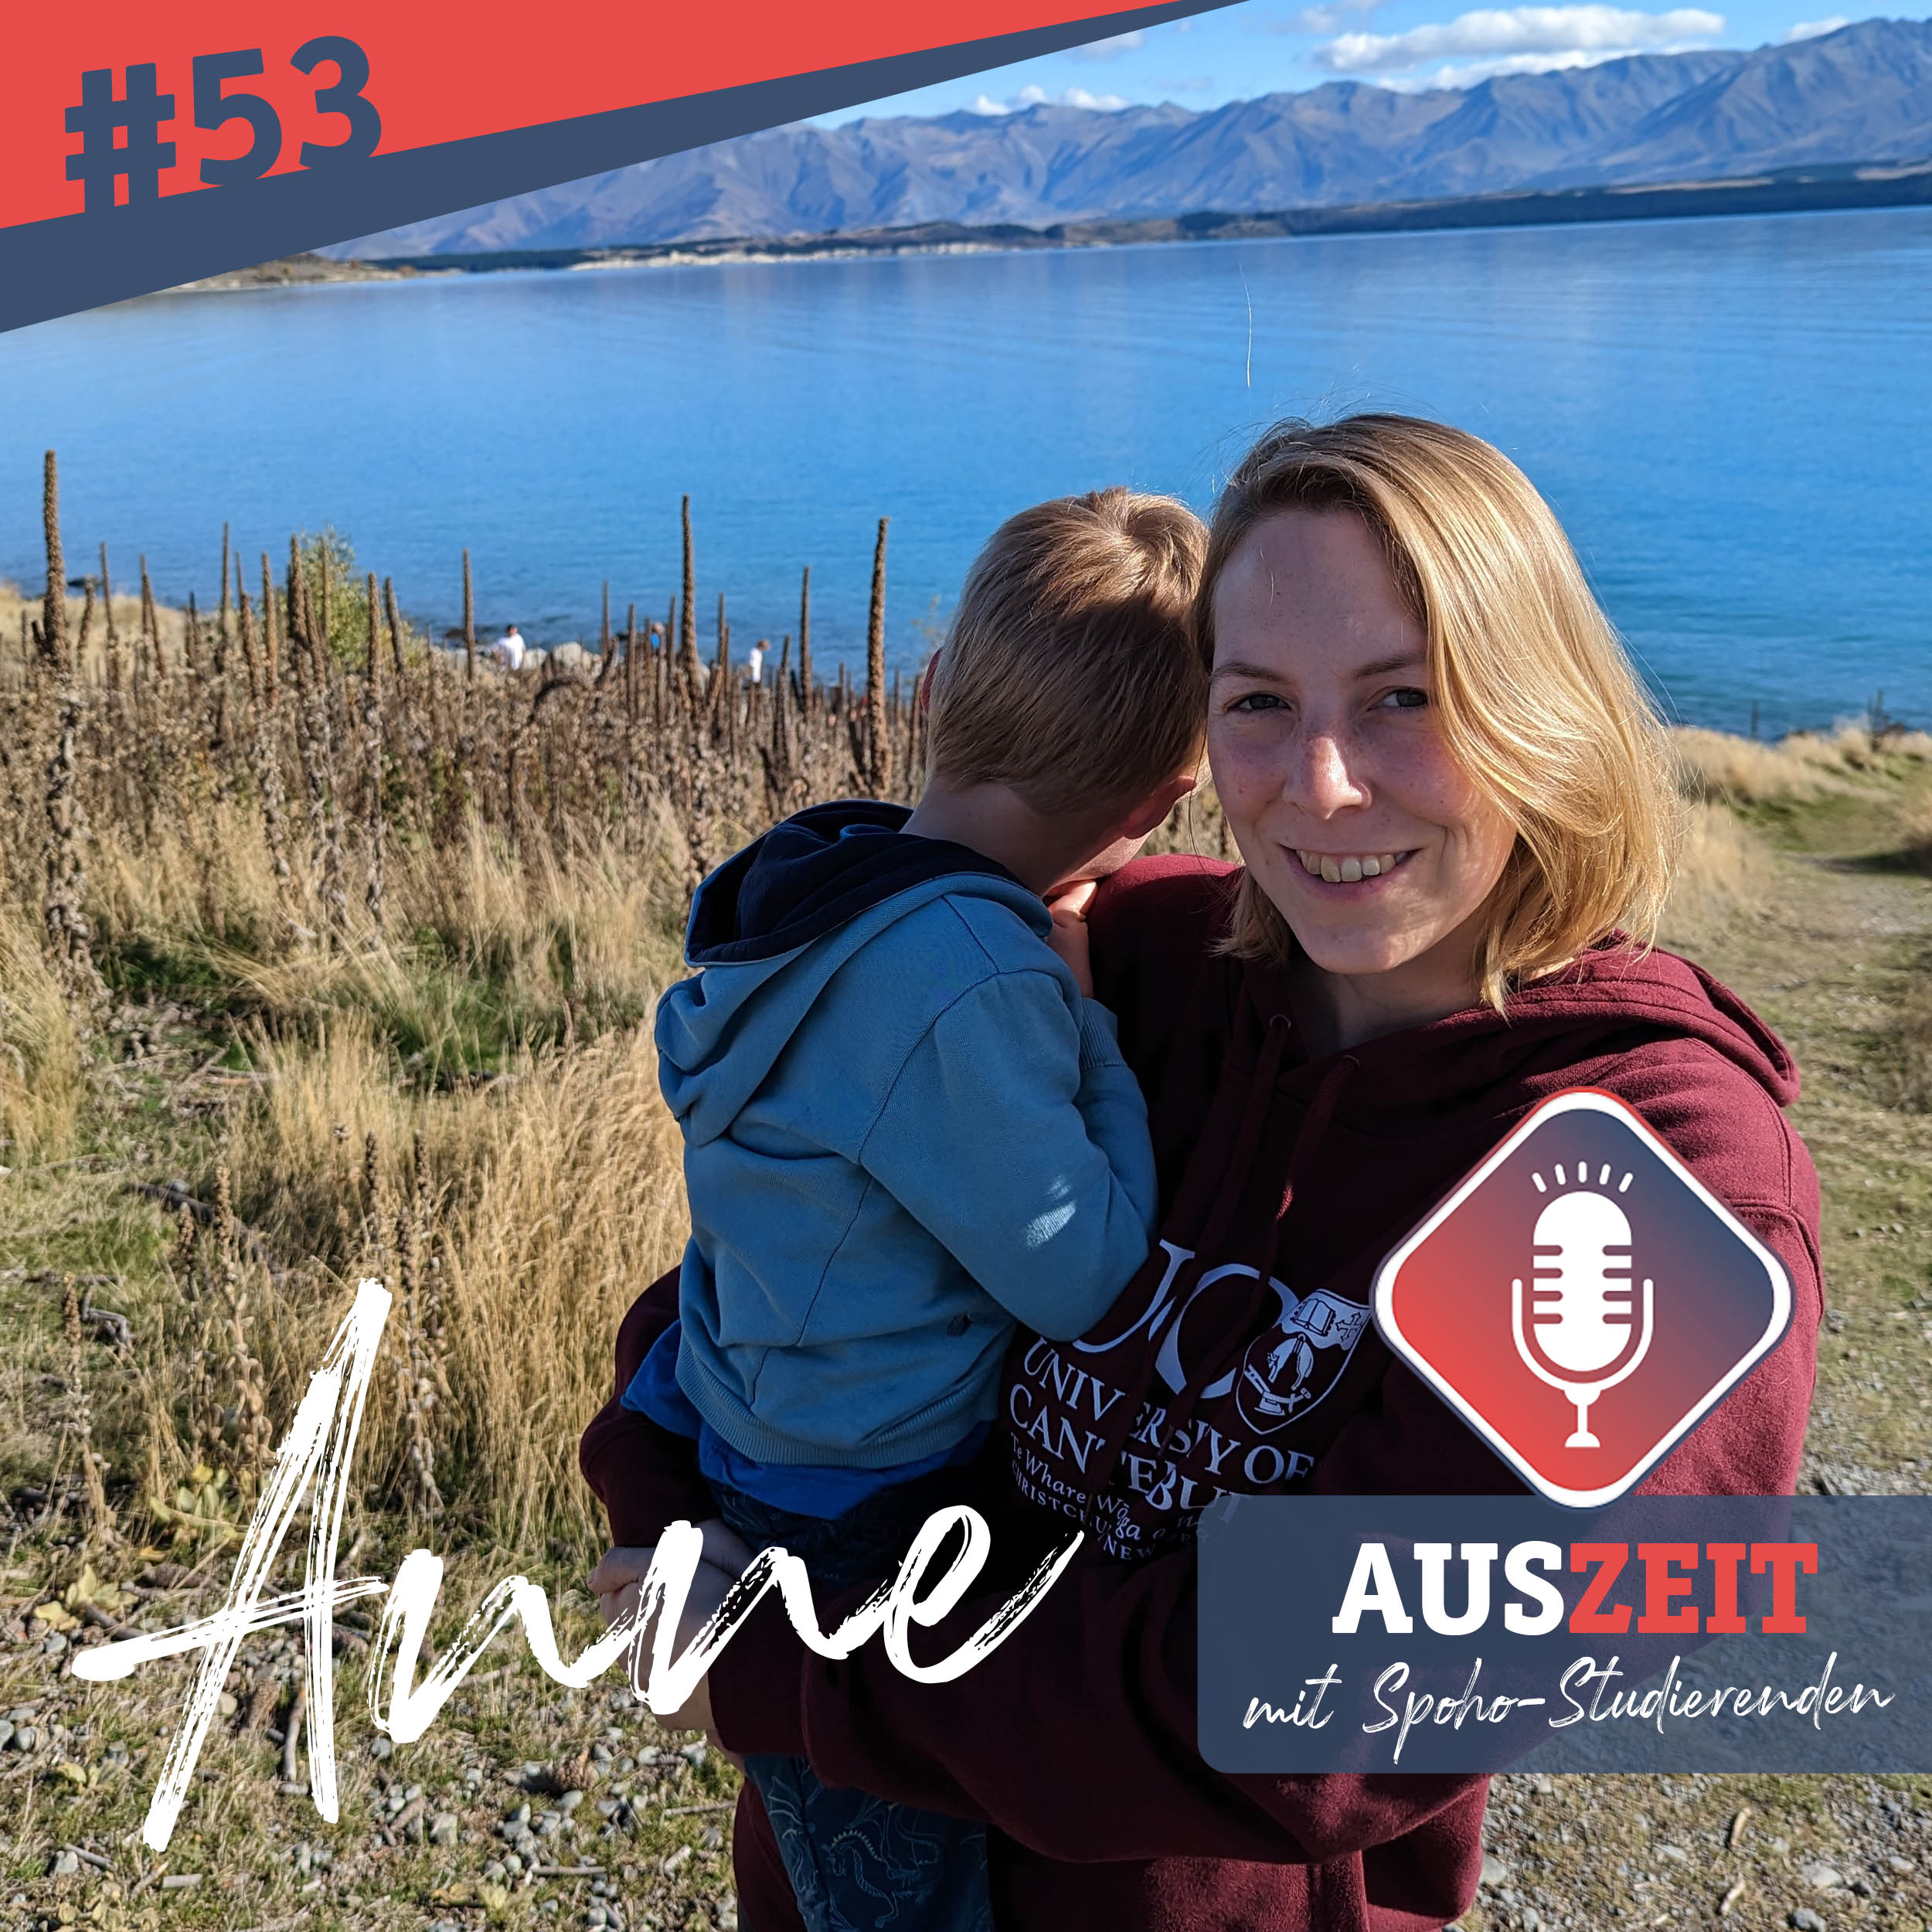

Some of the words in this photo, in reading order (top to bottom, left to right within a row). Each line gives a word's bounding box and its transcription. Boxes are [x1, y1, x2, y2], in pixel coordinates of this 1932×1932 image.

[1009, 1430, 1023, 1460] Te
[1025, 1447, 1087, 1504] Whare
[1243, 1444, 1315, 1485] OF
